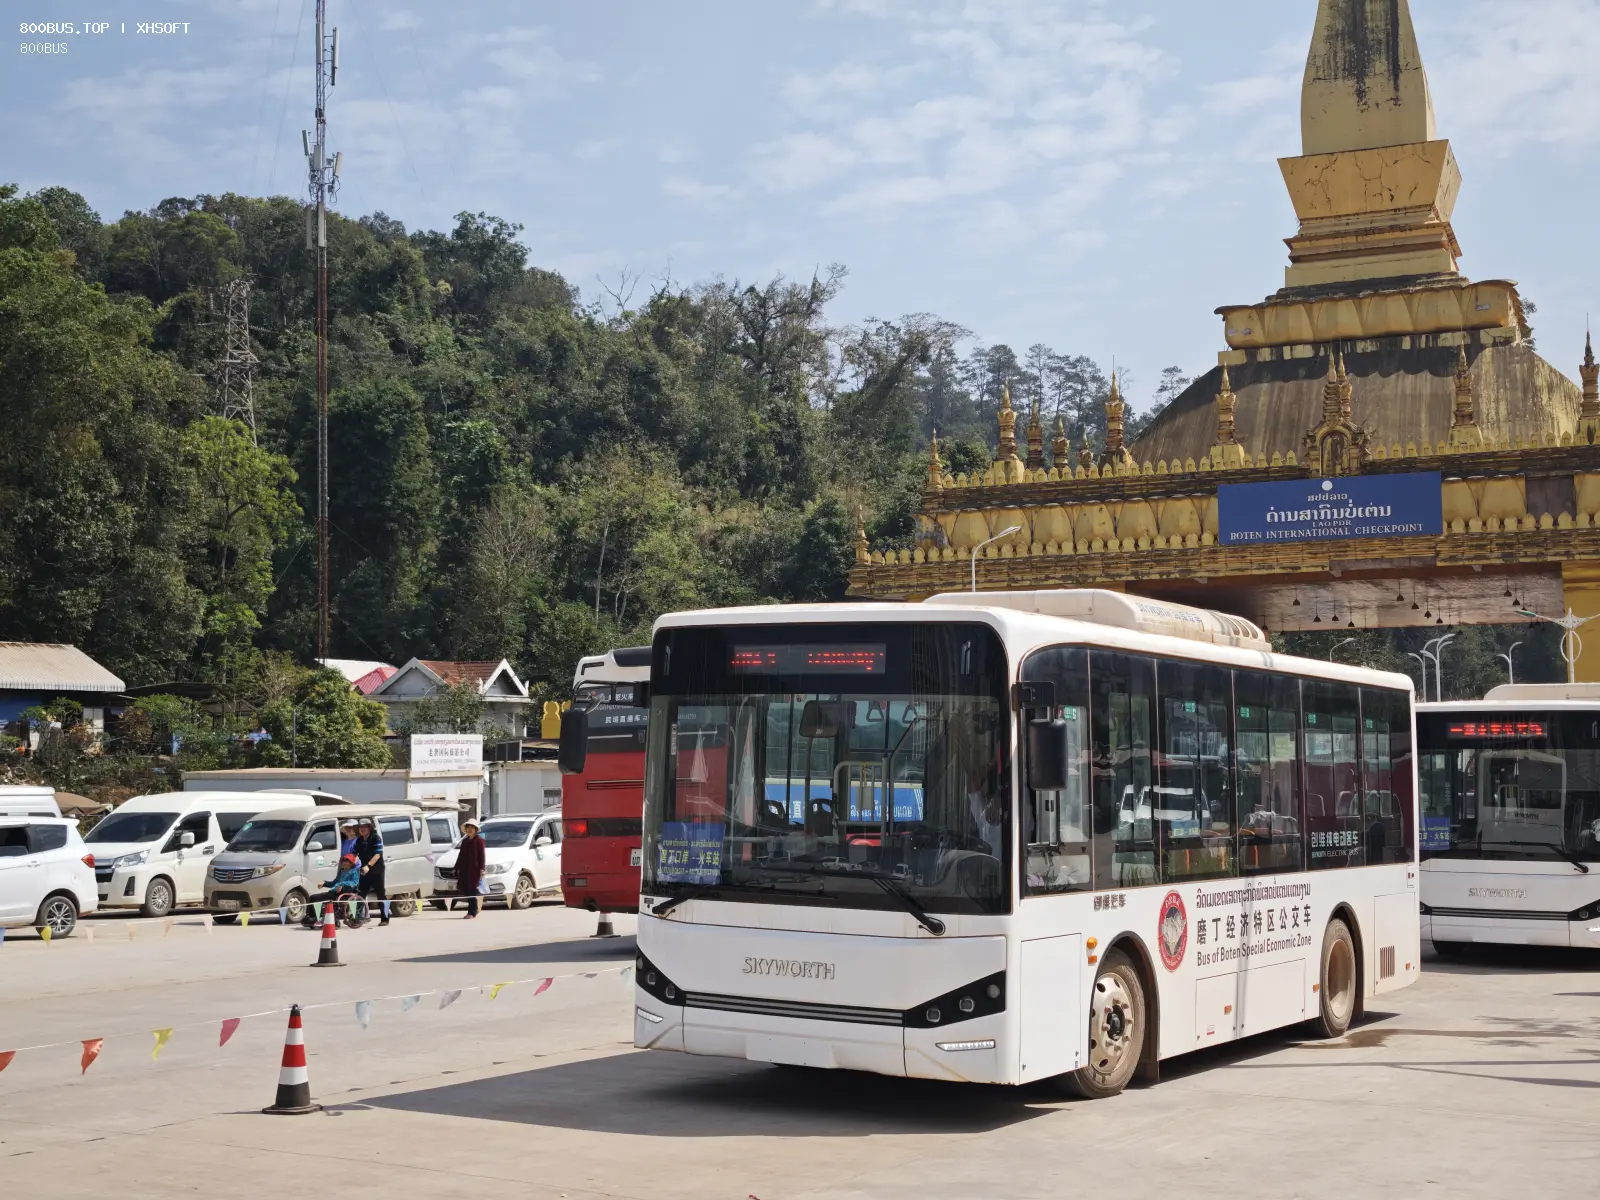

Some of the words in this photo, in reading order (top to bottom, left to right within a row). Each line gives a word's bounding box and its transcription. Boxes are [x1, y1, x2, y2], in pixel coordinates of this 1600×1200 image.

[1230, 531, 1262, 541] BOTEN
[1266, 527, 1351, 539] INTERNATIONAL
[1355, 523, 1424, 535] CHECKPOINT
[1327, 849, 1347, 857] ELECTRIC
[1196, 904, 1312, 945] 磨丁经济特区公交车
[1197, 951, 1211, 967] Bus
[1212, 949, 1220, 963] of
[1220, 945, 1240, 962] Boten
[1242, 939, 1266, 960] Special
[1266, 935, 1297, 954] Economic
[1297, 932, 1312, 947] Zone
[742, 956, 835, 980] SKYWORTH
